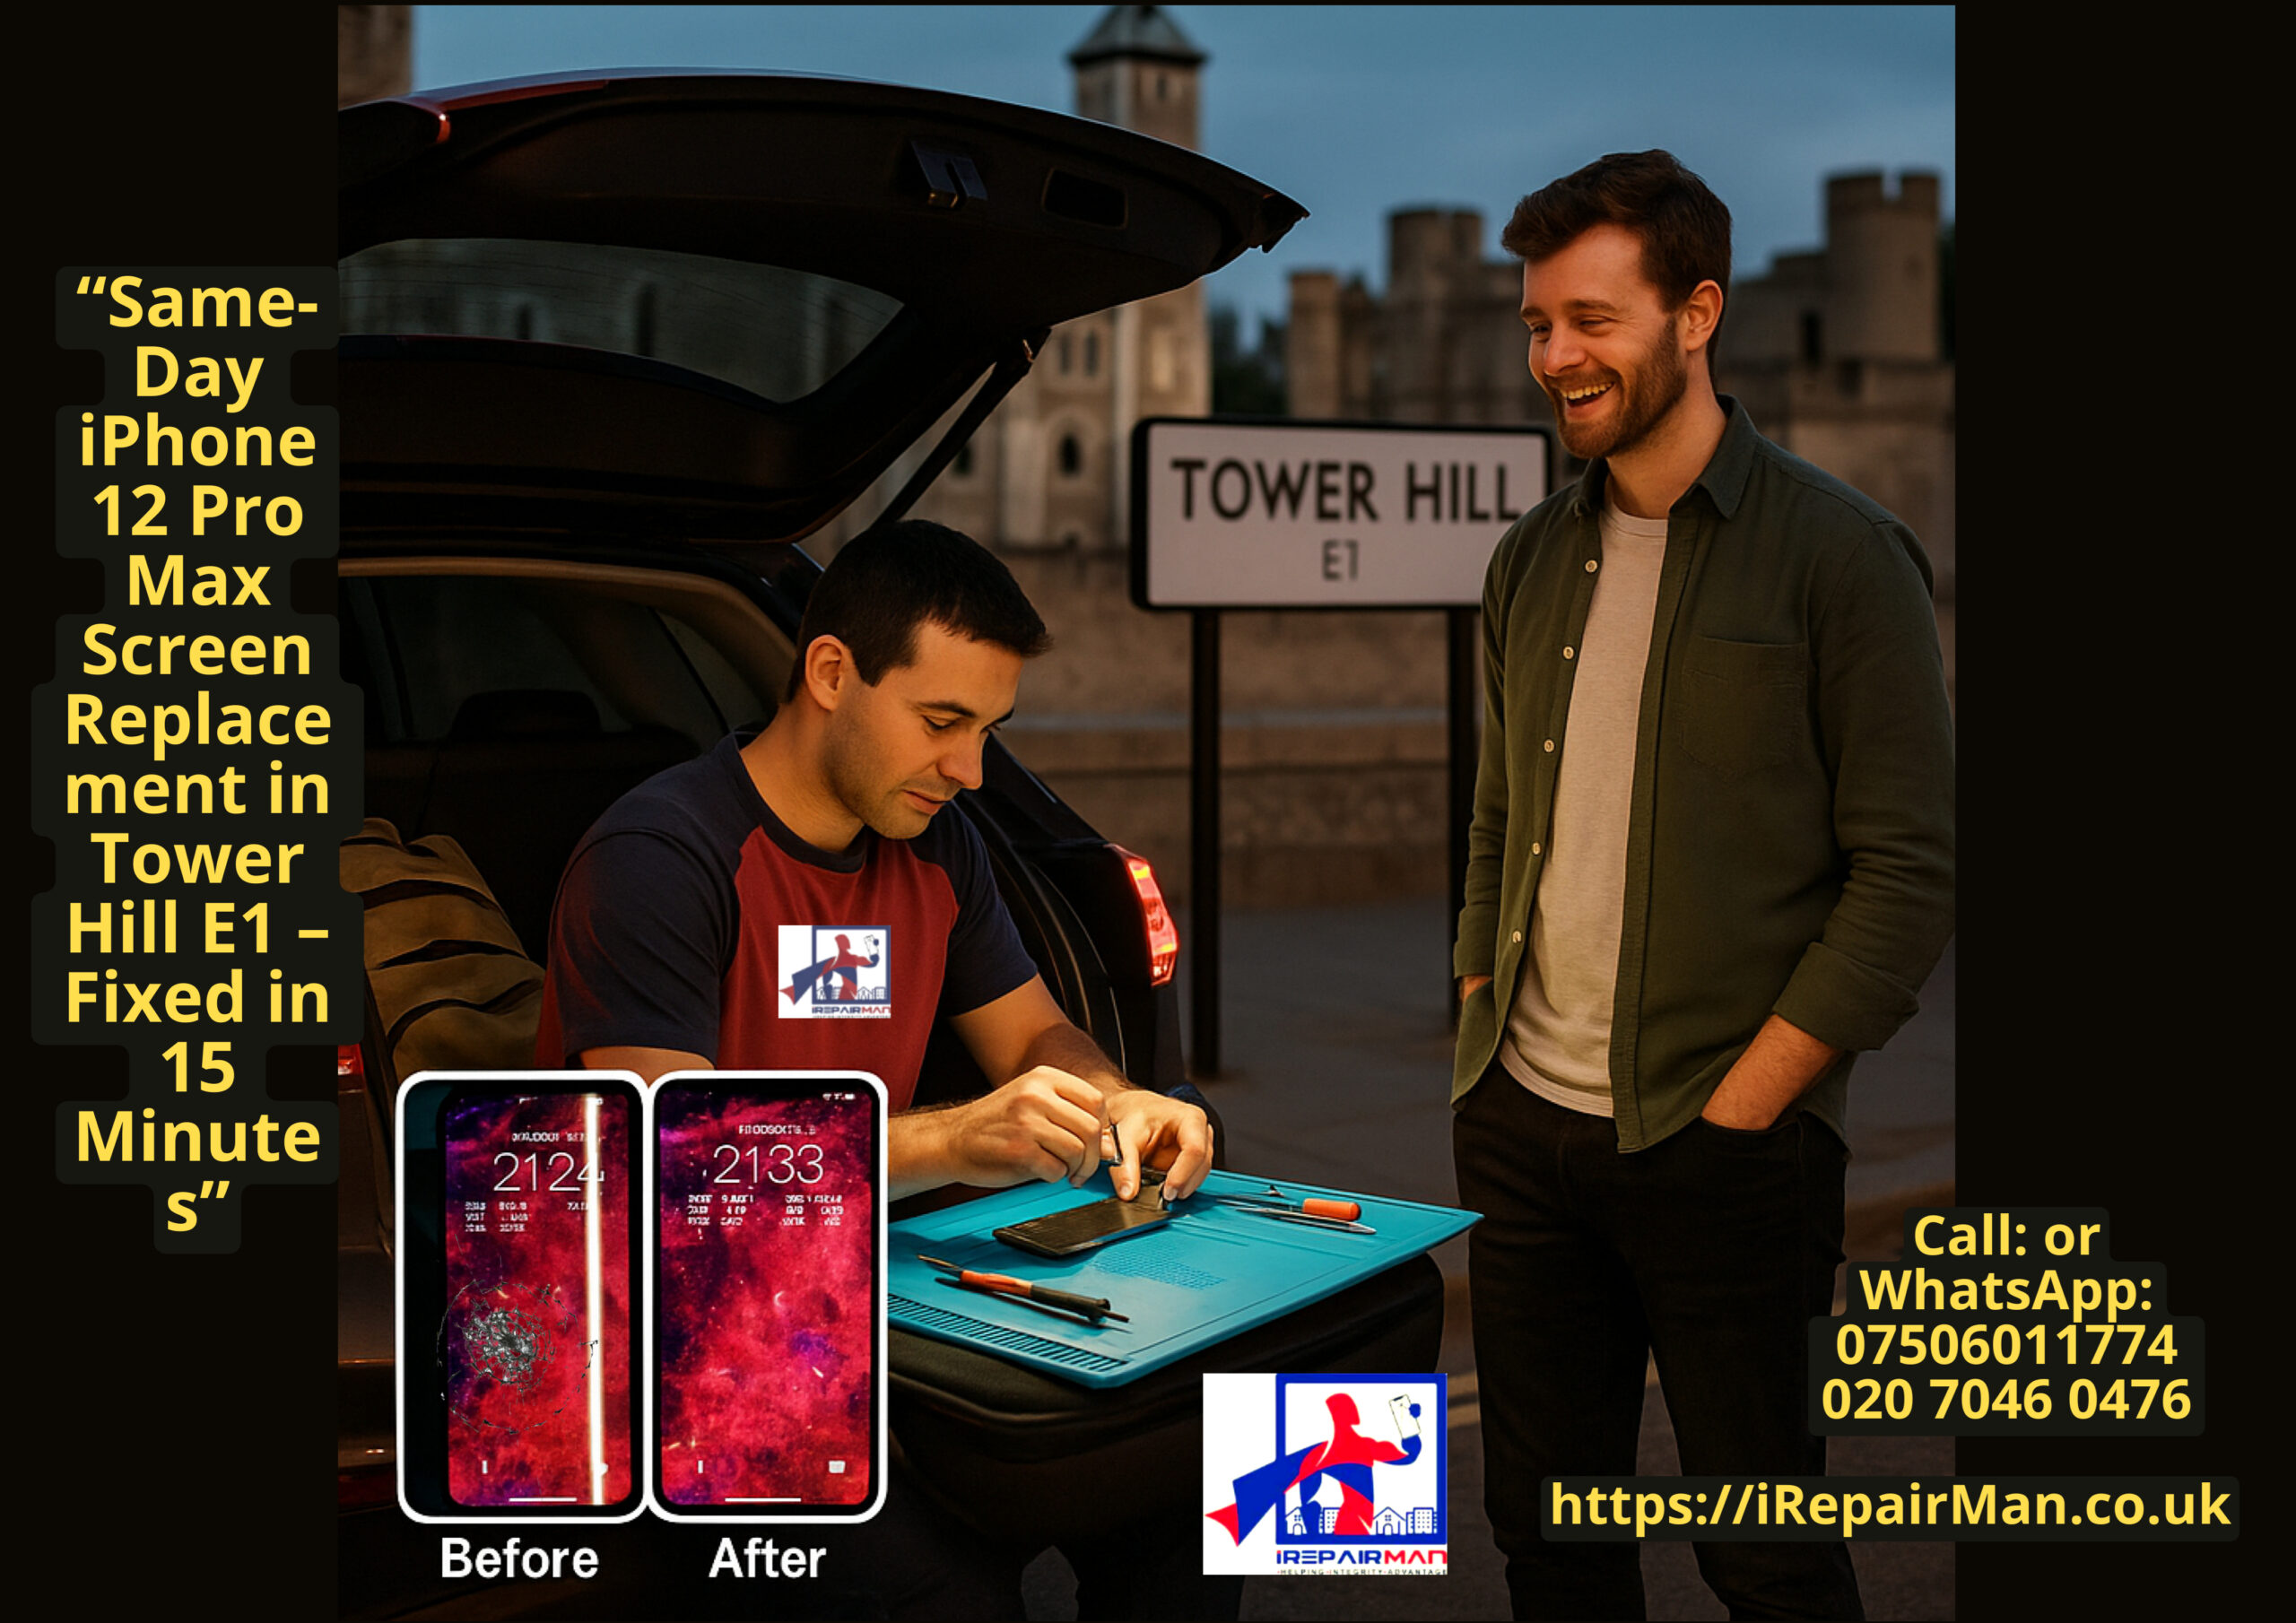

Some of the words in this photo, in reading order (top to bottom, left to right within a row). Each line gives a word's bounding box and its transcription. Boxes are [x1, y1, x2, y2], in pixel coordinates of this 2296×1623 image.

[1170, 458, 1378, 522] TOWER
[1406, 461, 1523, 523] HILL
[1322, 539, 1359, 581] E1
[713, 1144, 823, 1184] 2133
